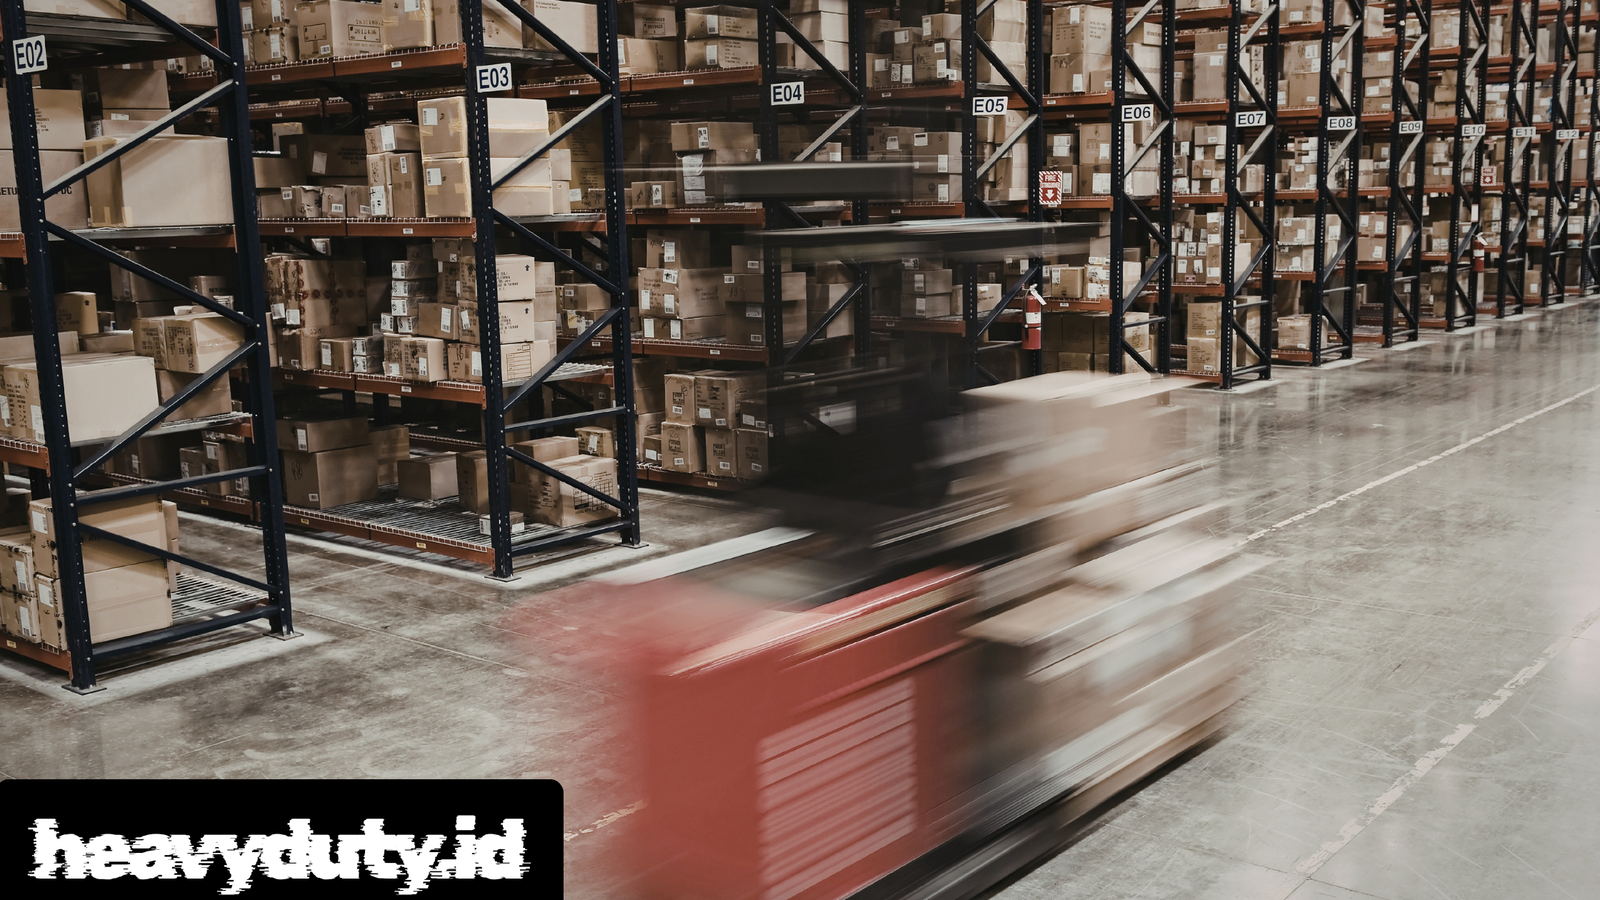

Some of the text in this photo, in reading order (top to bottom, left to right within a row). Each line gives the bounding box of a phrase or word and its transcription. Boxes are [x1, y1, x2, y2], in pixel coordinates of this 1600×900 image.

[15, 40, 44, 69] E02
[478, 66, 509, 89] E03
[773, 84, 802, 103] E04
[974, 98, 1004, 113] E05
[1124, 106, 1151, 119] E06
[1238, 113, 1264, 125] E07
[1329, 117, 1353, 128] E08
[1401, 123, 1421, 132] E09
[1464, 126, 1484, 135] E10
[1515, 128, 1533, 137] E11
[1558, 130, 1578, 138] E12
